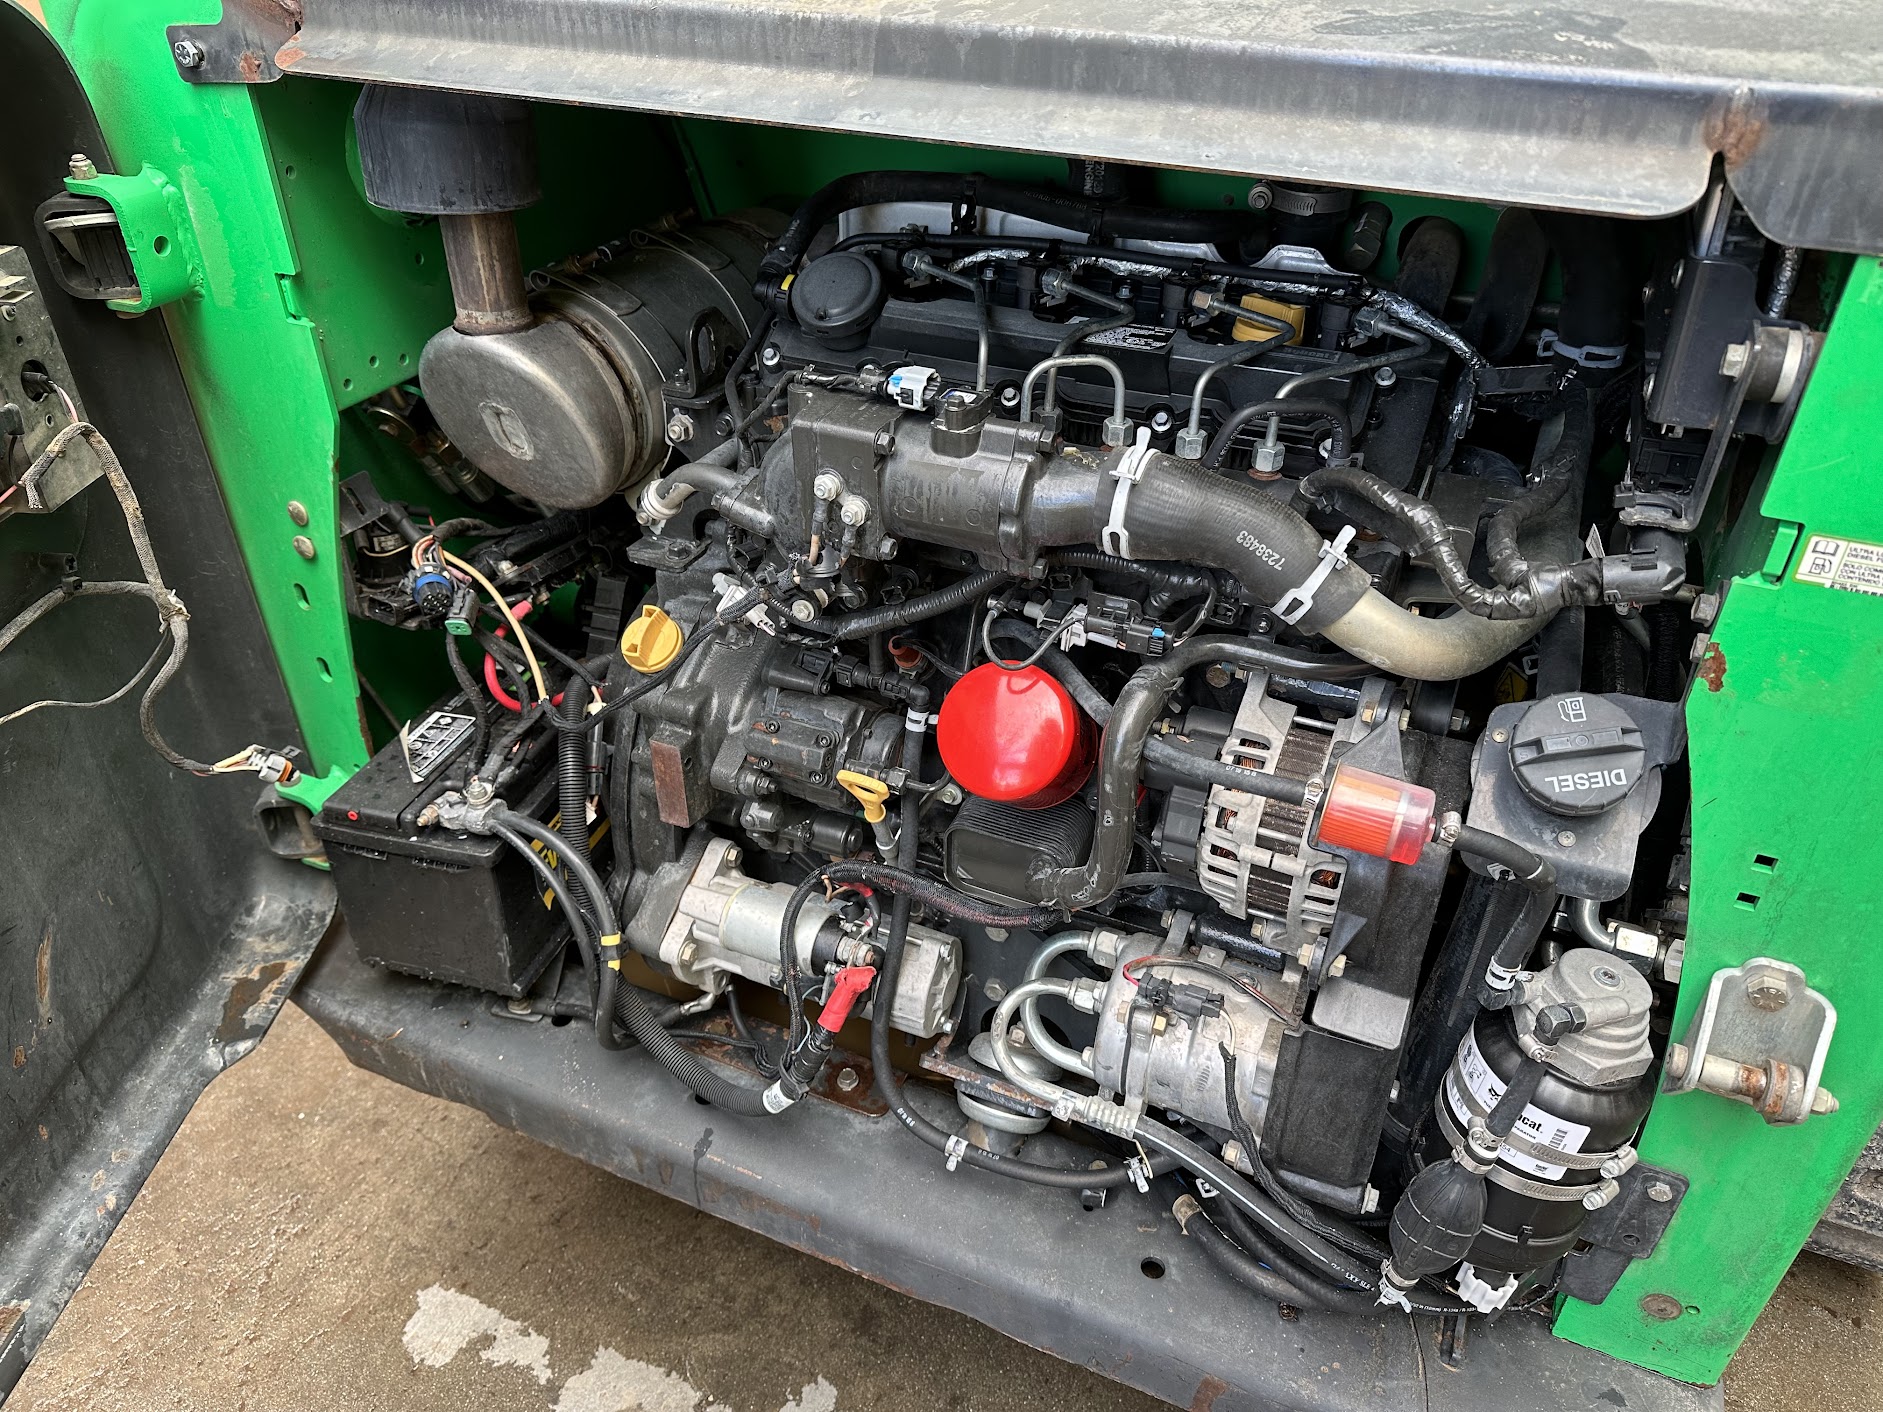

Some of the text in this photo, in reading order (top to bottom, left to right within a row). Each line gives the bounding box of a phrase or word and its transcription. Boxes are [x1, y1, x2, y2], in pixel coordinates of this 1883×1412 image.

[1236, 530, 1285, 571] 7238483
[1847, 552, 1873, 561] DIESEL
[1849, 546, 1874, 556] ULTRA
[1838, 573, 1881, 585] CONTENIDO
[1858, 571, 1880, 580] ULTRA
[1545, 768, 1627, 793] DIESEL
[1517, 1113, 1542, 1132] cat
